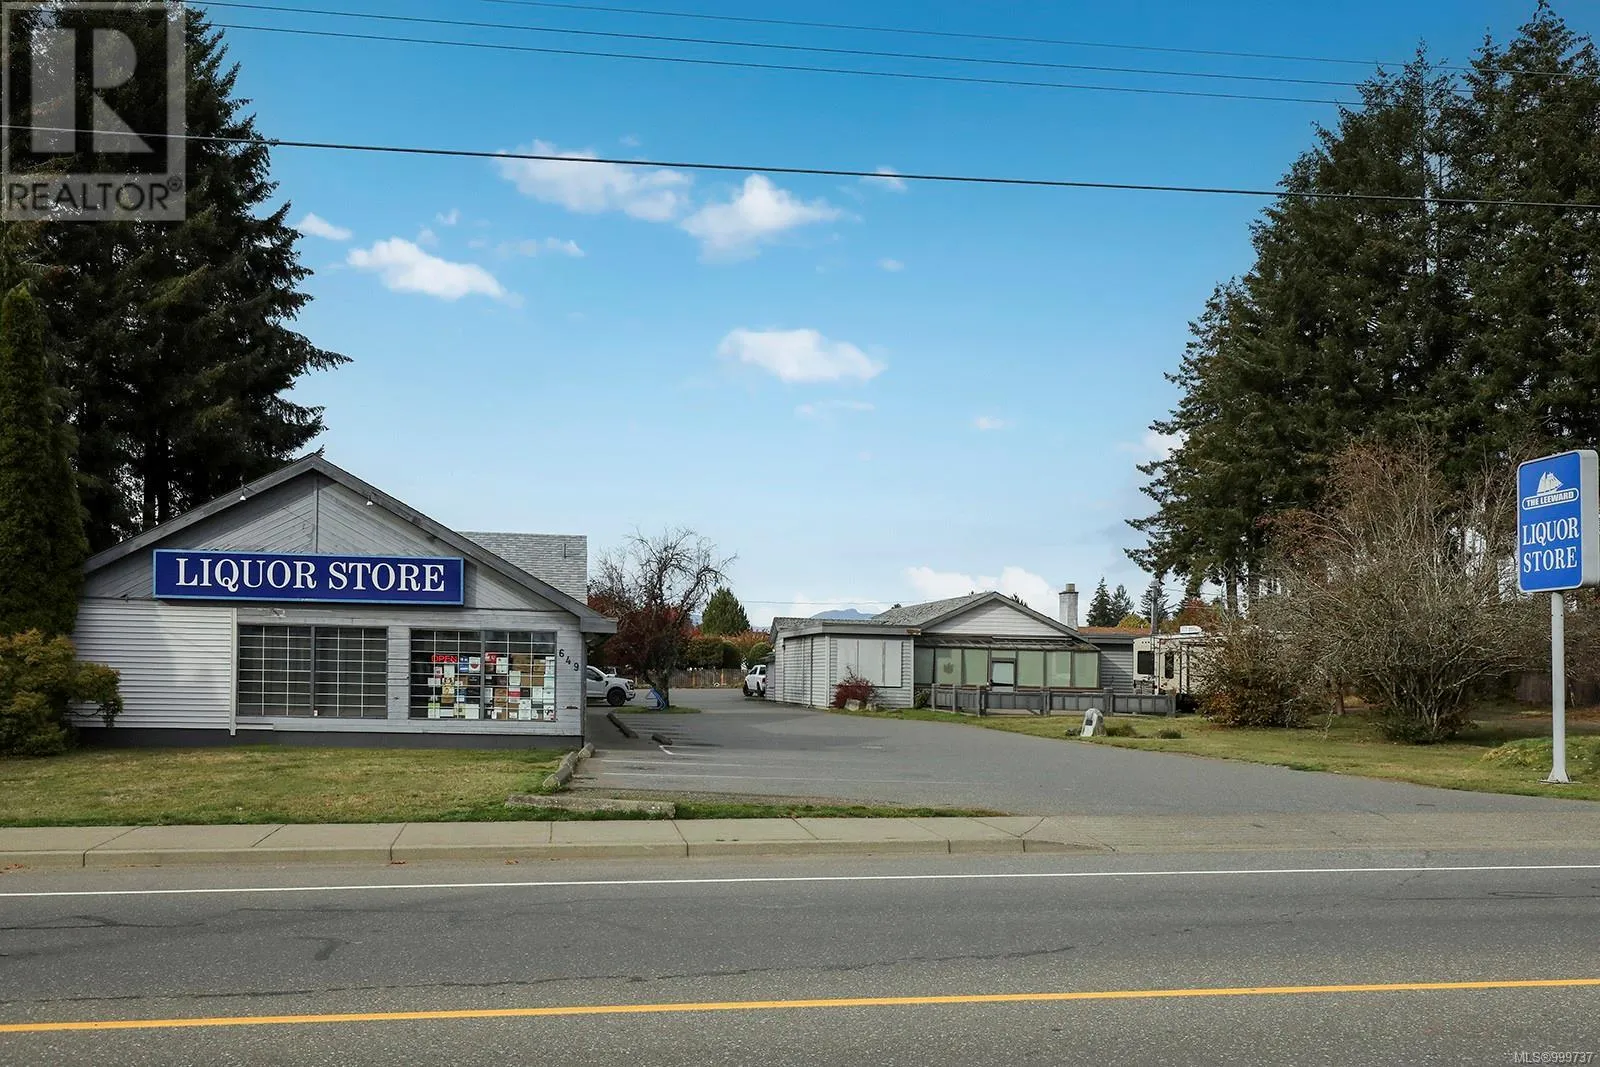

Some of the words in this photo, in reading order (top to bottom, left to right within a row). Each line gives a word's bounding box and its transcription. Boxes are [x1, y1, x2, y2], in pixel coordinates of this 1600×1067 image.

[1526, 497, 1540, 507] THE
[1540, 491, 1574, 505] LEEWARD
[1522, 517, 1580, 546] LIQUOR
[1523, 546, 1578, 573] STORE
[175, 557, 317, 592] LIQUOR
[328, 560, 445, 592] STORE
[431, 655, 458, 663] OPEN
